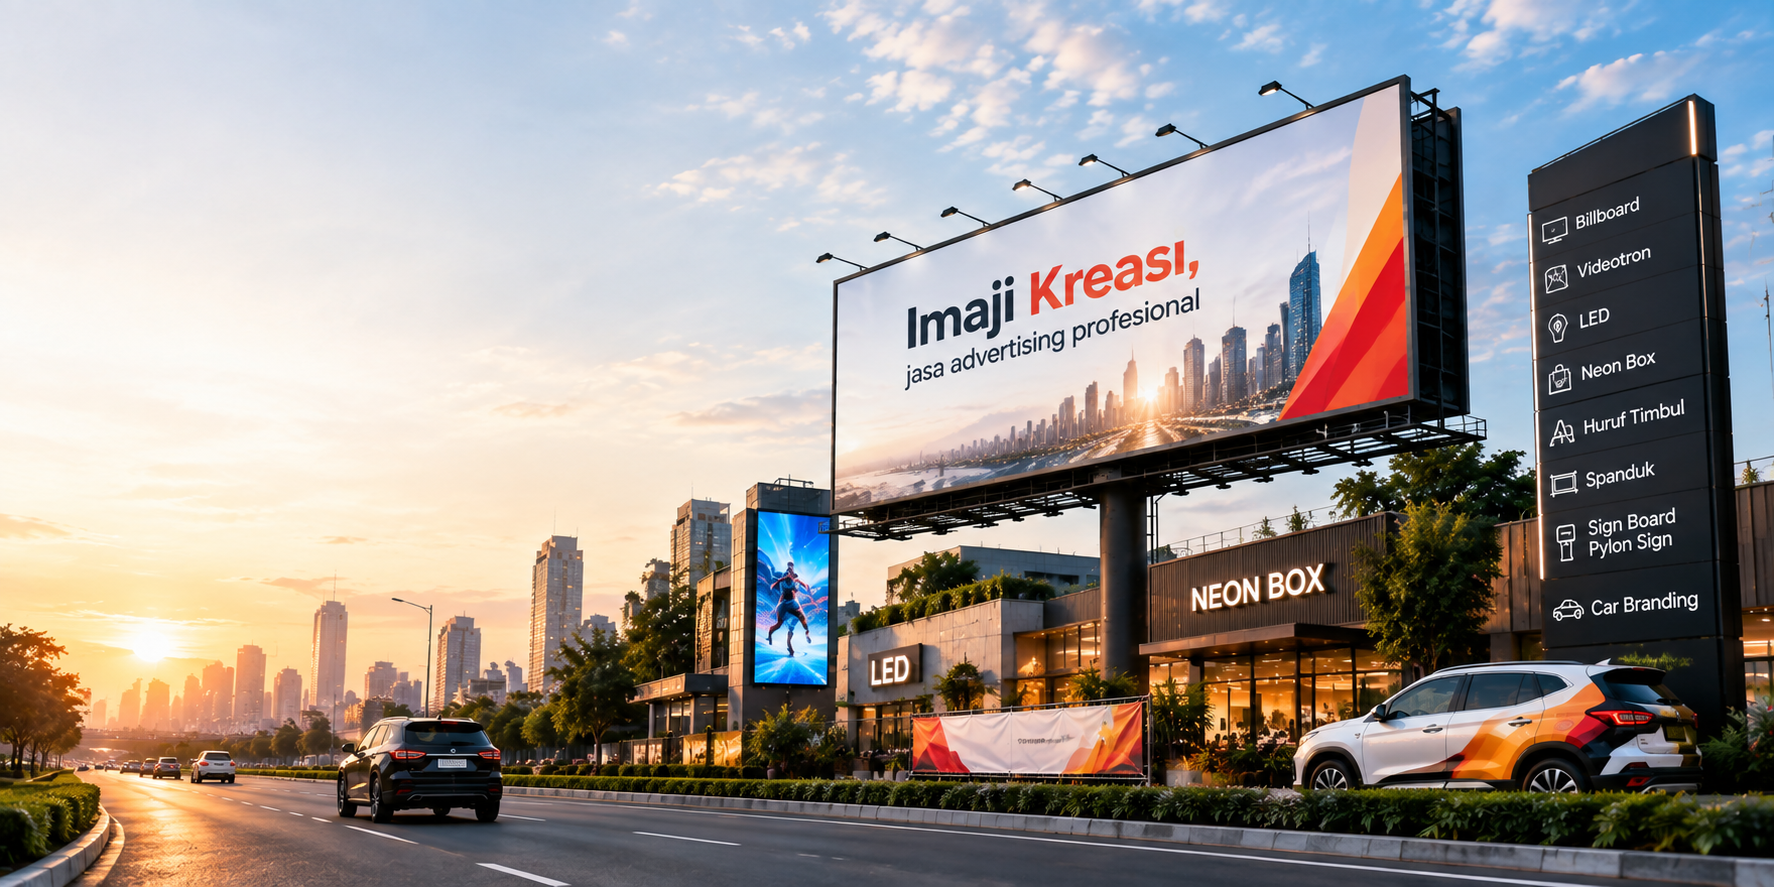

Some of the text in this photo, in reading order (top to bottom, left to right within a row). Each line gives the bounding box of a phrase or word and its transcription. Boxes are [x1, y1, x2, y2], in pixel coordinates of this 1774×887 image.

[1575, 195, 1640, 230] Billboard
[1576, 247, 1652, 278] Videotron
[907, 276, 1015, 350] Imaji
[1579, 307, 1610, 329] LED
[904, 287, 1200, 391] jasa advertising profesional
[1581, 352, 1656, 381] Neon Box
[1583, 398, 1685, 435] Huruf Timbul
[1585, 461, 1656, 490] Spanduk
[1588, 506, 1676, 538] Sign Board
[1589, 531, 1673, 560] Pylon Sign
[1191, 563, 1325, 612] NEON BOX
[1590, 591, 1699, 616] Car Branding
[871, 654, 910, 686] LED
